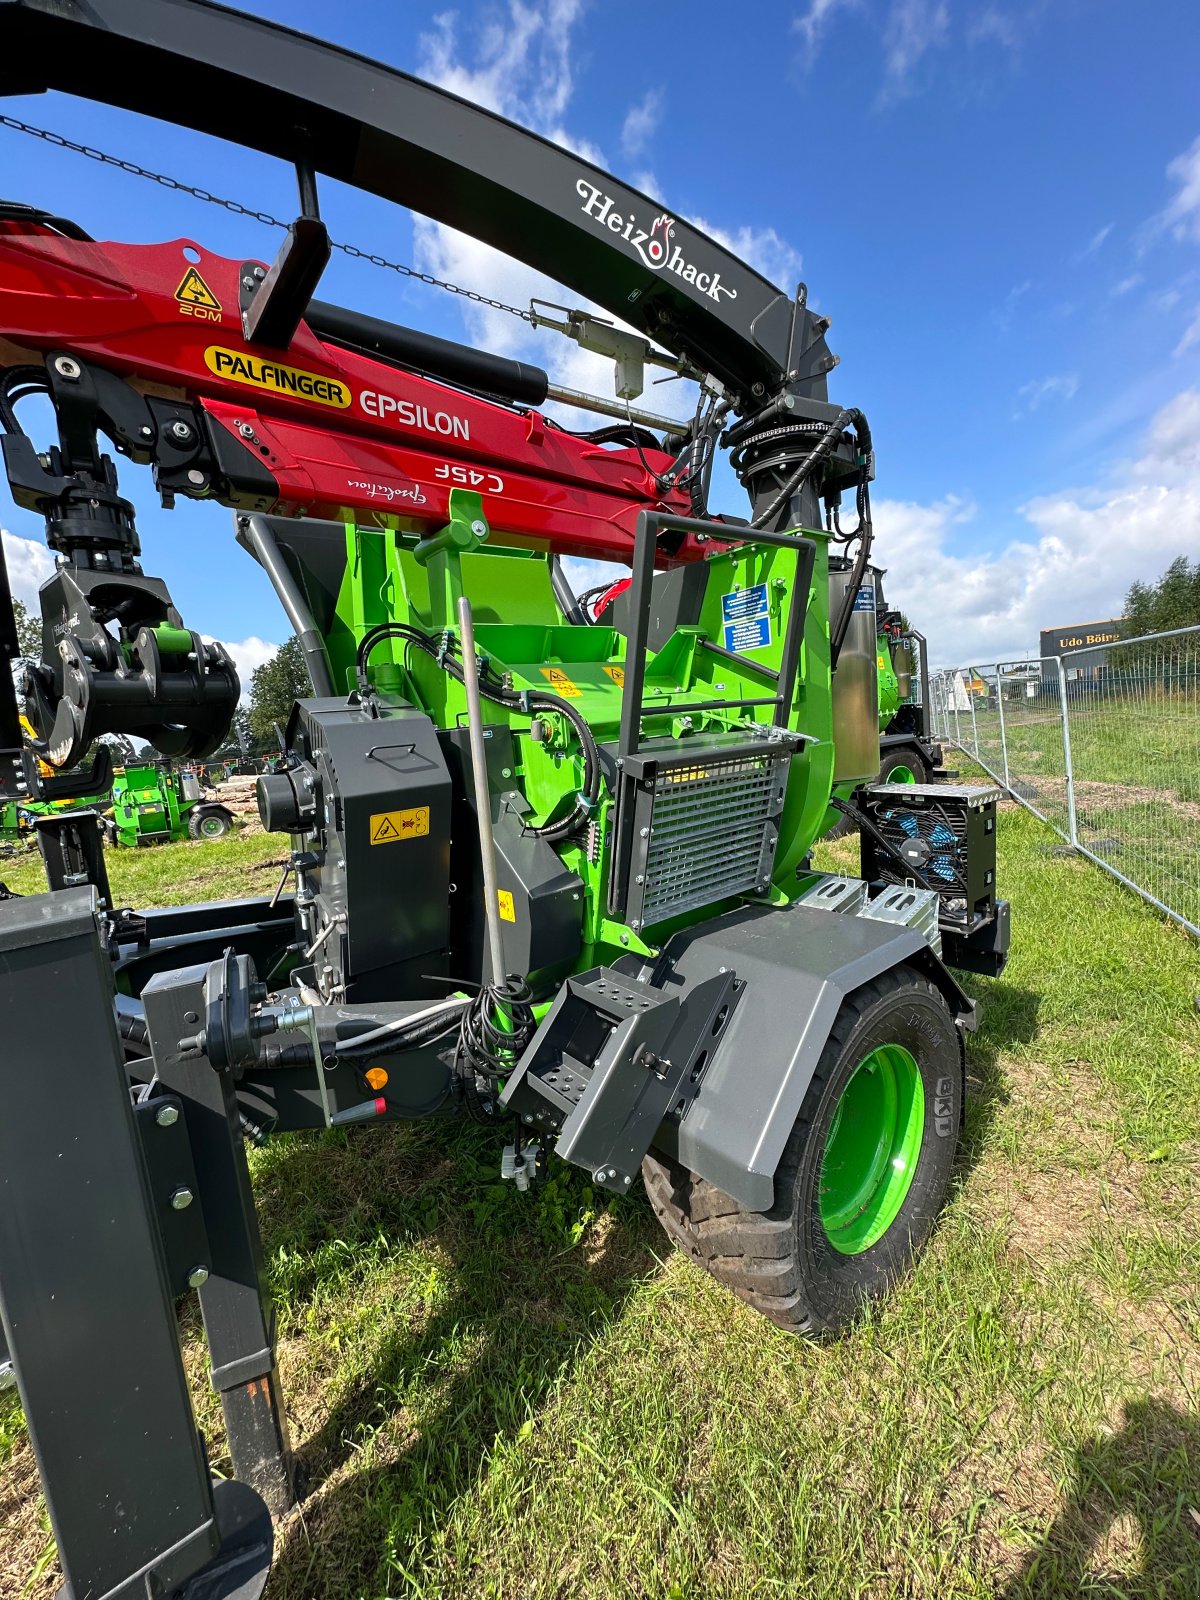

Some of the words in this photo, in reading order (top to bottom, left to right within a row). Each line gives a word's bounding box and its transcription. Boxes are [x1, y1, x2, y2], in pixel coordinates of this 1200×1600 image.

[179, 303, 222, 323] 20M
[215, 351, 344, 404] PALFINGER
[360, 390, 470, 441] EPSILON
[434, 464, 504, 493] C45F
[1059, 637, 1083, 648] Udo
[935, 1077, 954, 1137] BKT
